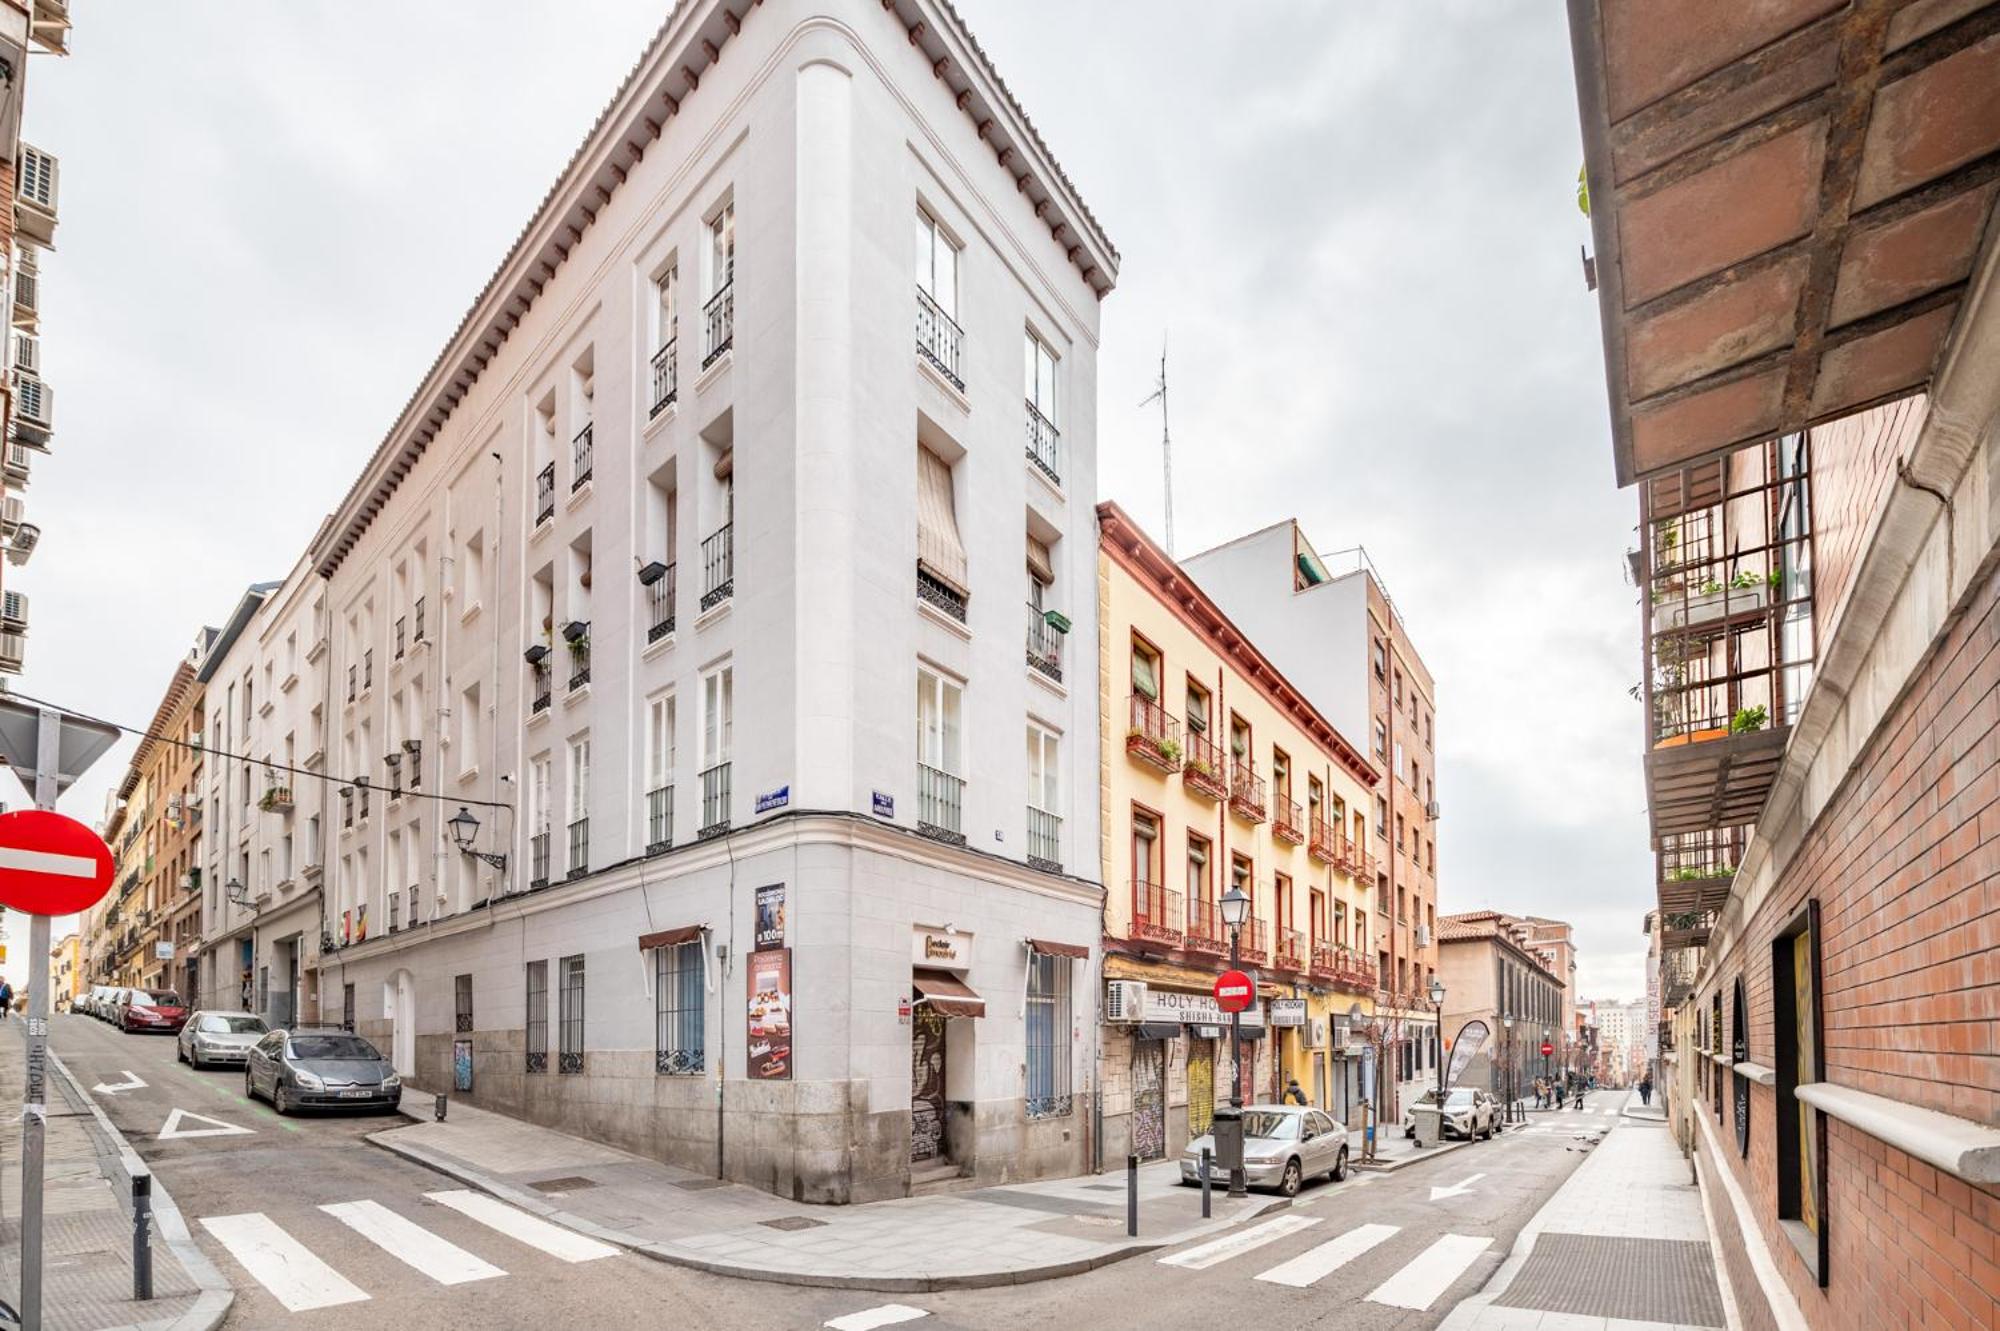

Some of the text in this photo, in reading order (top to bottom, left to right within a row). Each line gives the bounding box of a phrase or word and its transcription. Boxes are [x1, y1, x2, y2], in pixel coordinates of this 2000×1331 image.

[1157, 993, 1194, 1009] HOLY
[1179, 1011, 1232, 1023] SHISHA BAR
[1648, 1000, 1660, 1035] MUSEO
